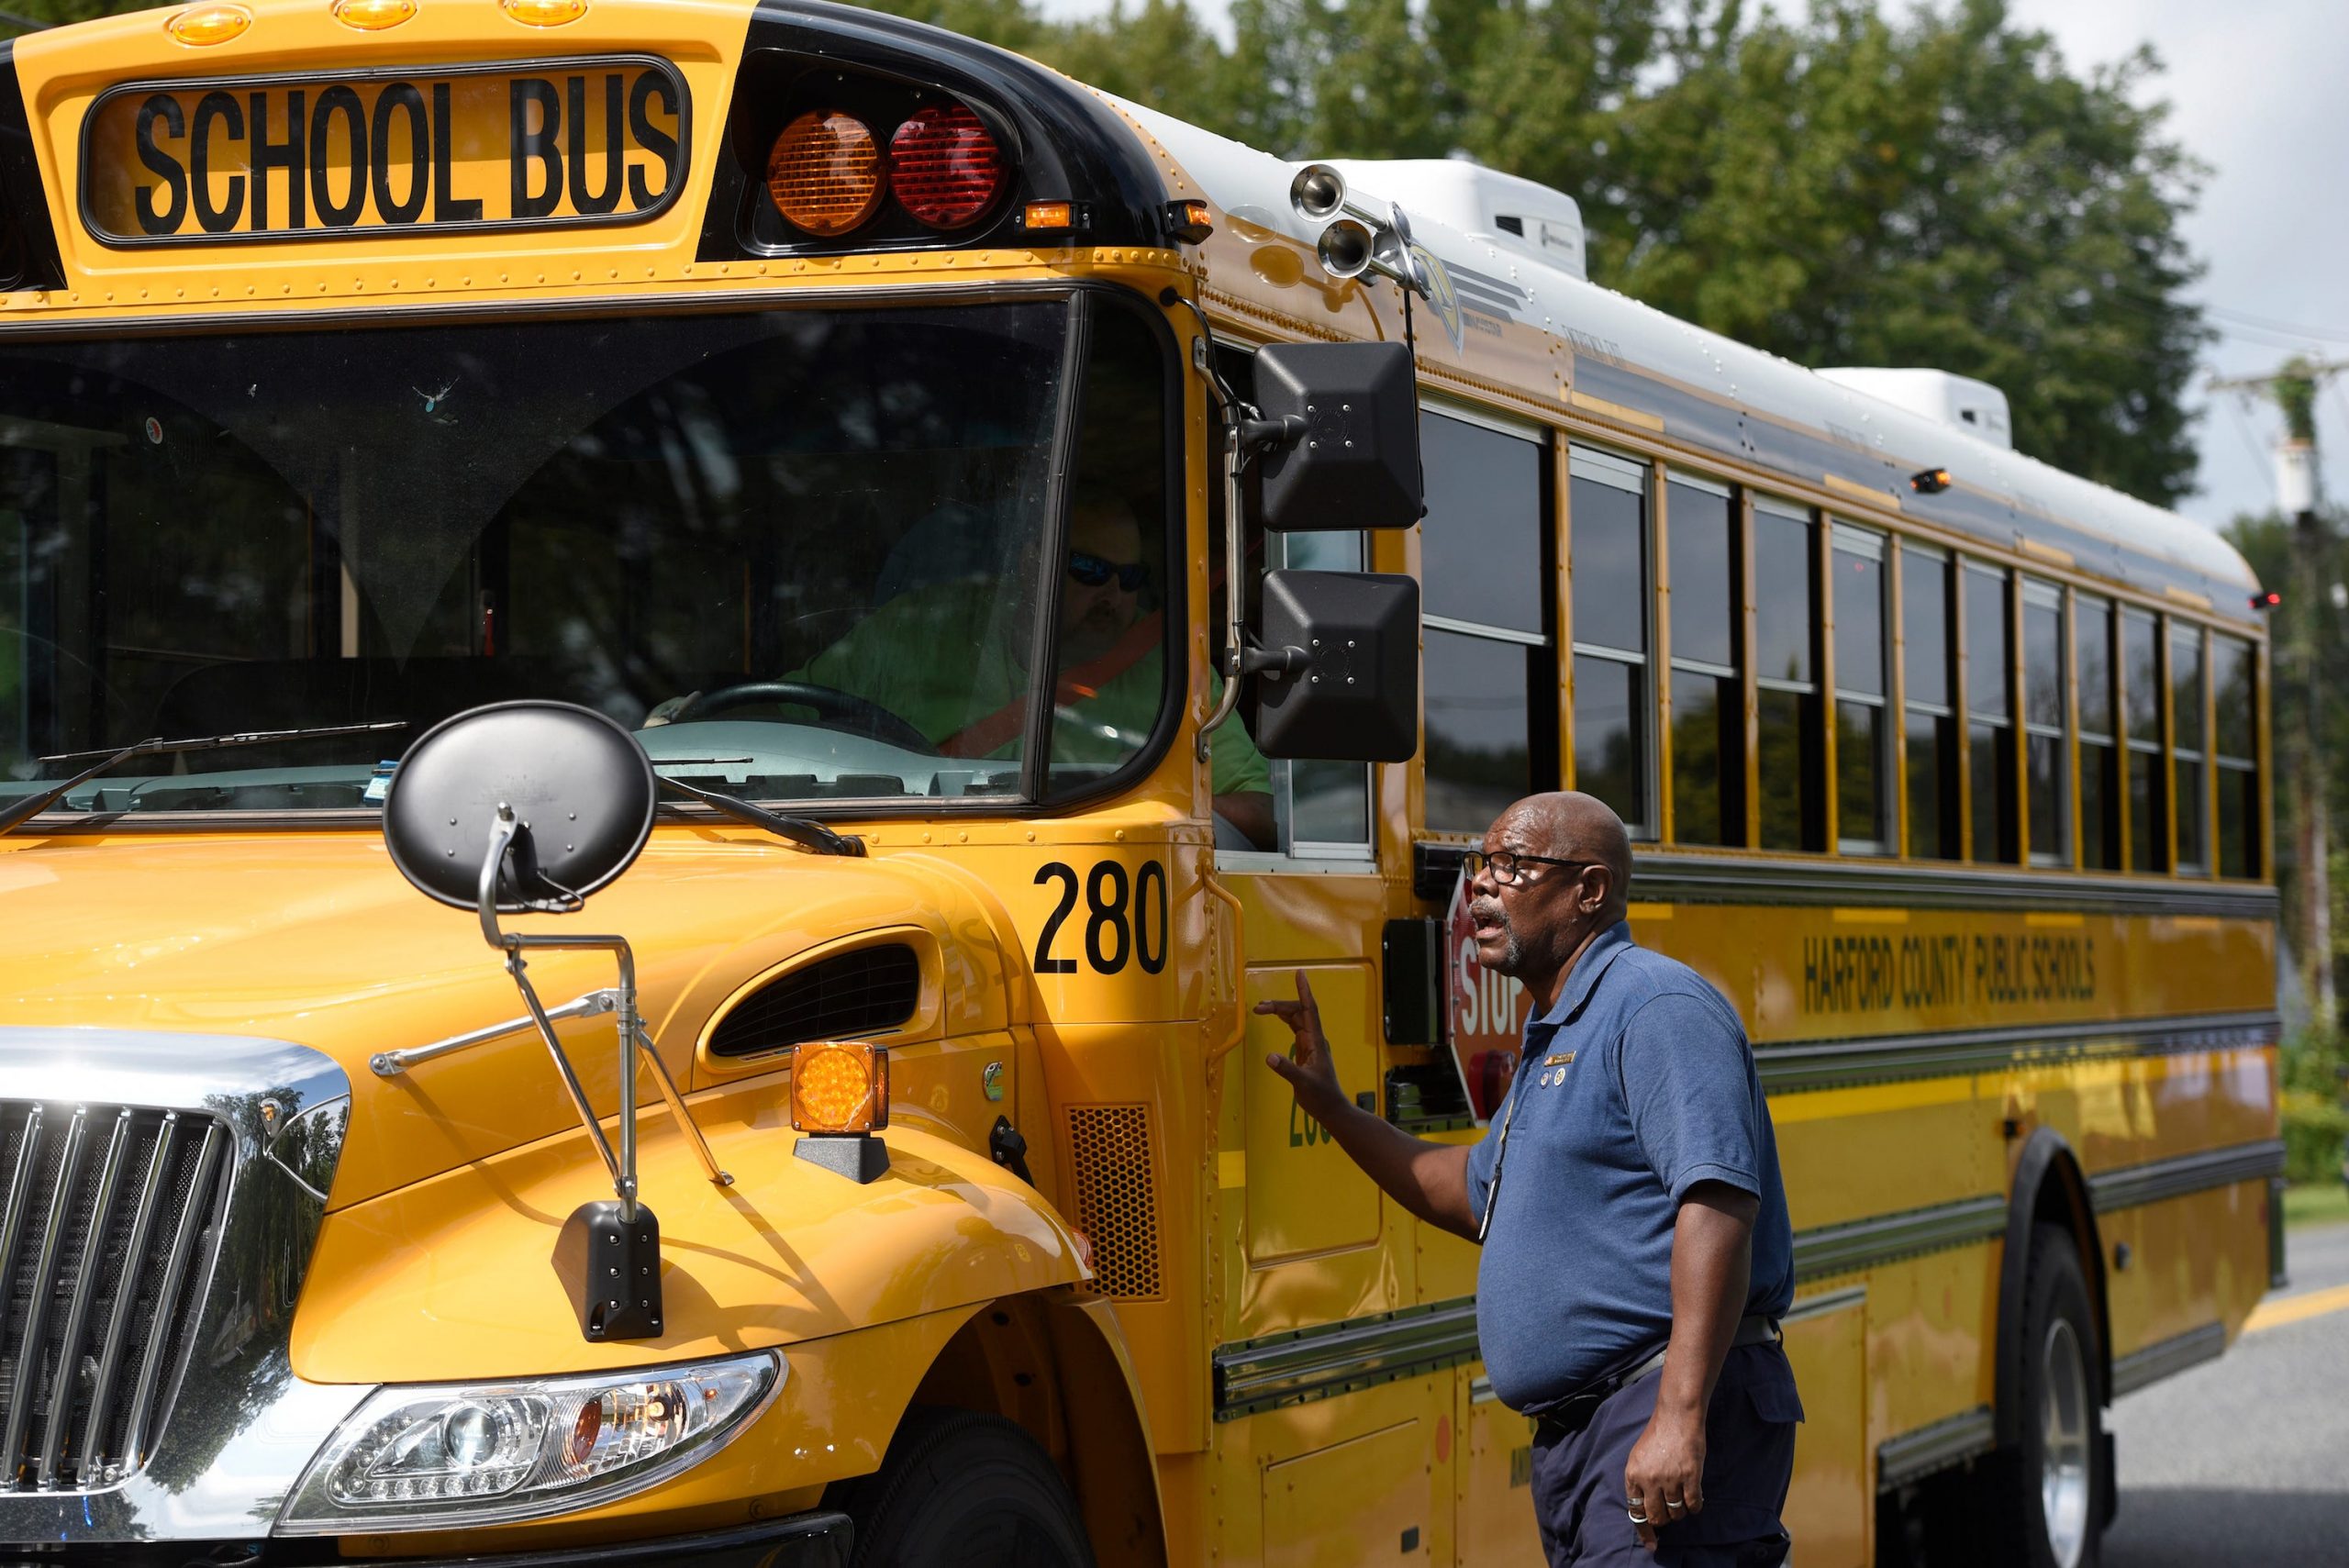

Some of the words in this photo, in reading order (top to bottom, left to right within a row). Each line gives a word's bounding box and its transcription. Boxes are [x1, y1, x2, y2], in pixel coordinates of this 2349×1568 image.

[135, 83, 484, 235] SCHOOL
[511, 71, 679, 218] BUS
[1033, 861, 1168, 975] 280
[1804, 936, 1894, 1013] HARFORD
[1900, 933, 1967, 1008] COUNTY
[1976, 934, 2028, 1001] PUBLIC
[2032, 936, 2096, 1001] SCHOOLS
